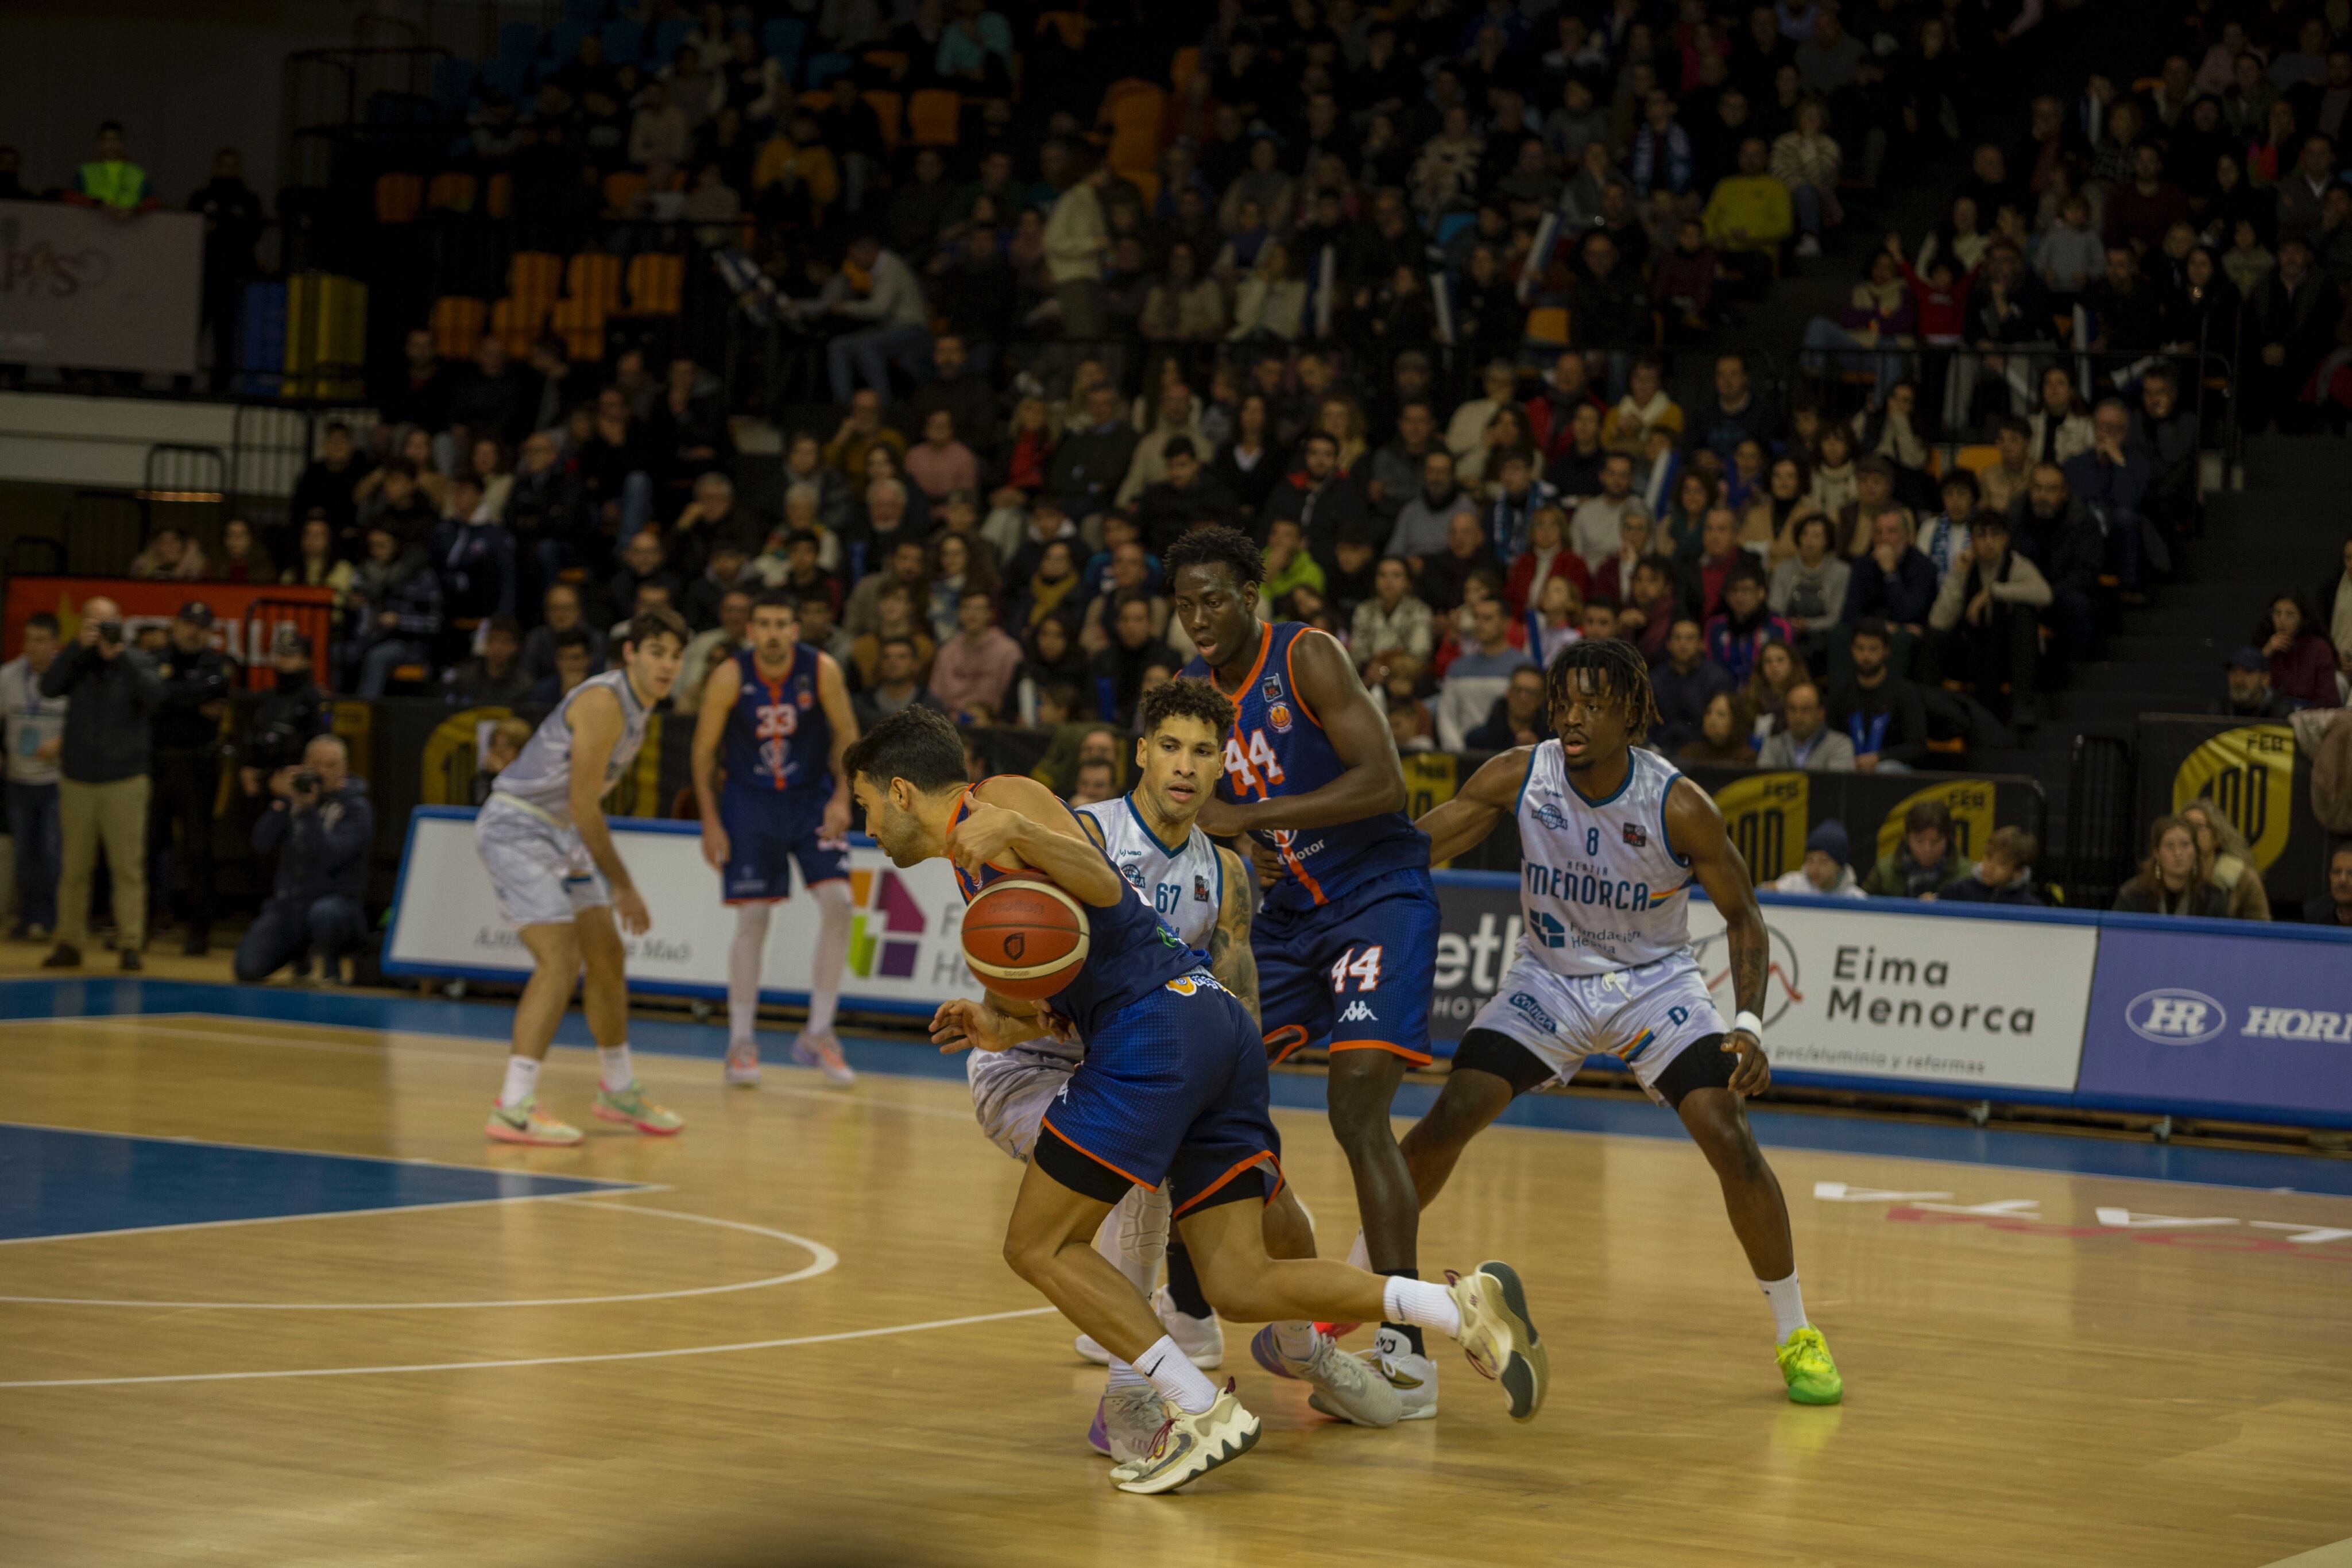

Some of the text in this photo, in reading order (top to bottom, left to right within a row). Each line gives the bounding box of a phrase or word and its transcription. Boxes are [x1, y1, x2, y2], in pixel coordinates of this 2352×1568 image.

[755, 703, 798, 740] 33
[1224, 729, 1286, 792] 44
[2246, 733, 2284, 752] FEB
[1586, 827, 1599, 856] 8
[1156, 882, 1182, 915] 67
[1527, 862, 1649, 912] MENORCA
[1330, 946, 1382, 994] 44
[1835, 946, 1948, 986] Eima
[1827, 987, 2036, 1035] Menorca
[2142, 998, 2207, 1036] HR
